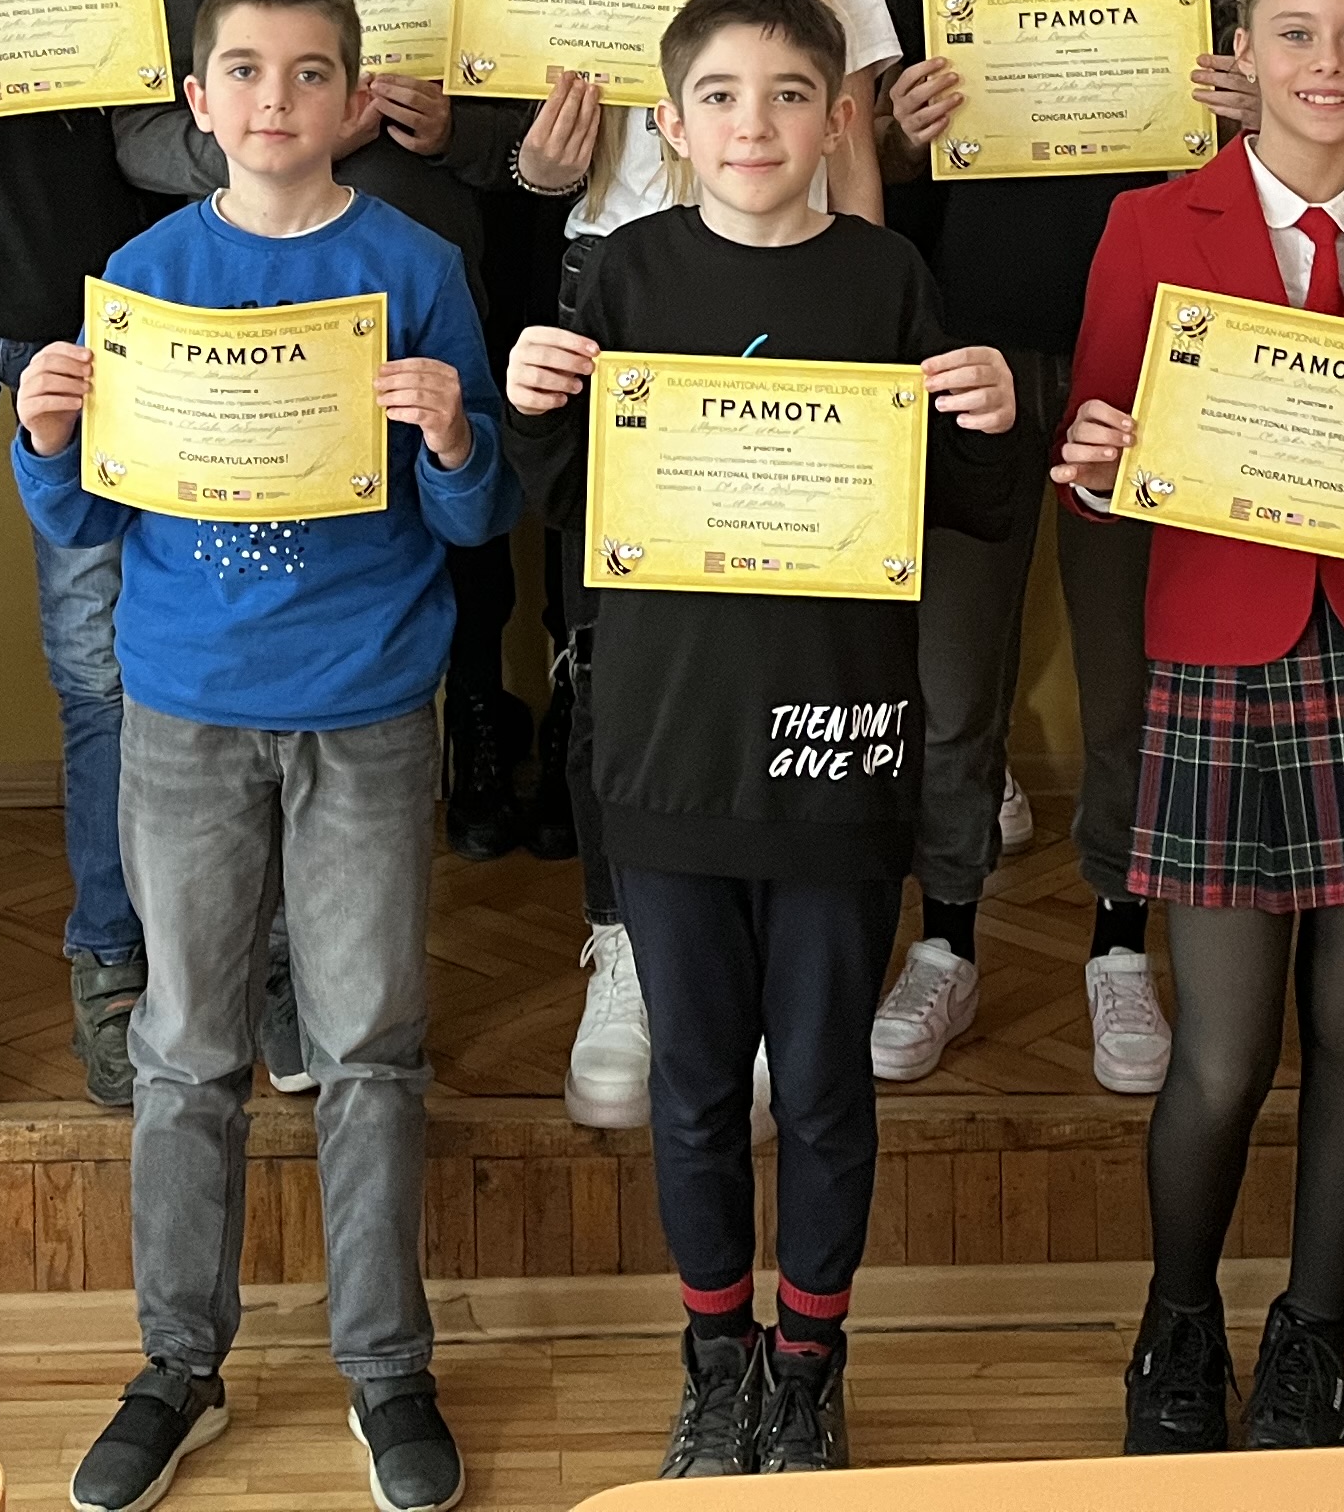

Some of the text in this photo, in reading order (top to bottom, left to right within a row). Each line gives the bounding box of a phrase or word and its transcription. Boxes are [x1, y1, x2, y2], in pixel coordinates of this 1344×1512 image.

[361, 19, 432, 33] RATULATIONS!
[1018, 8, 1138, 28] ГРАМОТА
[549, 36, 645, 52] CONGRATULATIONS!
[1032, 110, 1128, 122] CONGRATULATIONS!
[170, 342, 306, 365] ГРАМОТА
[1170, 350, 1201, 366] BEE
[702, 398, 841, 423] ГРАМОТА
[615, 415, 646, 428] BEE
[178, 450, 288, 465] CONGRATULATIONS!
[707, 517, 820, 533] CONGRATULATIONS!
[771, 703, 848, 742] THEN
[769, 745, 854, 781] GIVE
